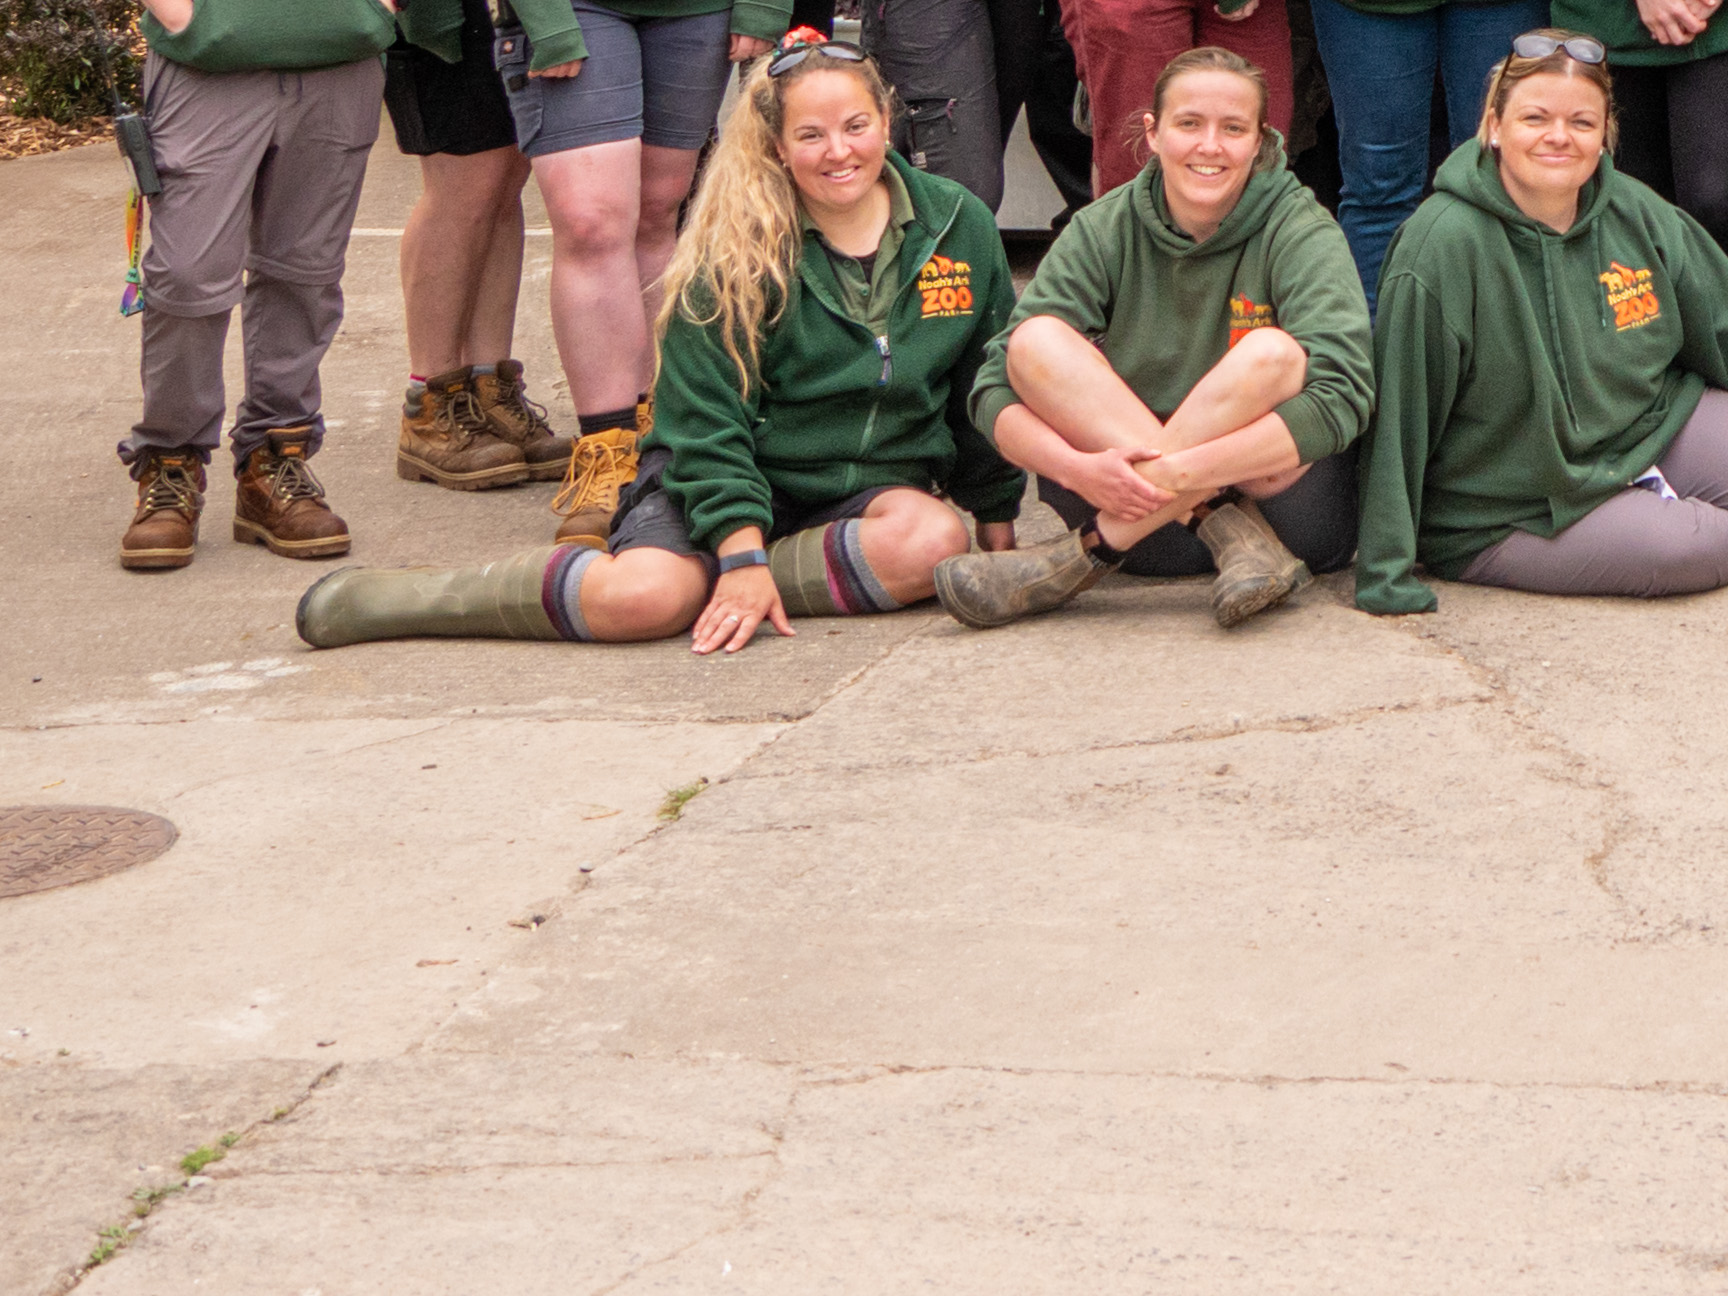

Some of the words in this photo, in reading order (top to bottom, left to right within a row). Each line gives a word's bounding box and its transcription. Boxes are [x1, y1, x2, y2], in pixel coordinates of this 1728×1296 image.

[918, 276, 952, 291] Noah's
[922, 286, 973, 313] ZOO
[1614, 291, 1659, 328] ZOO
